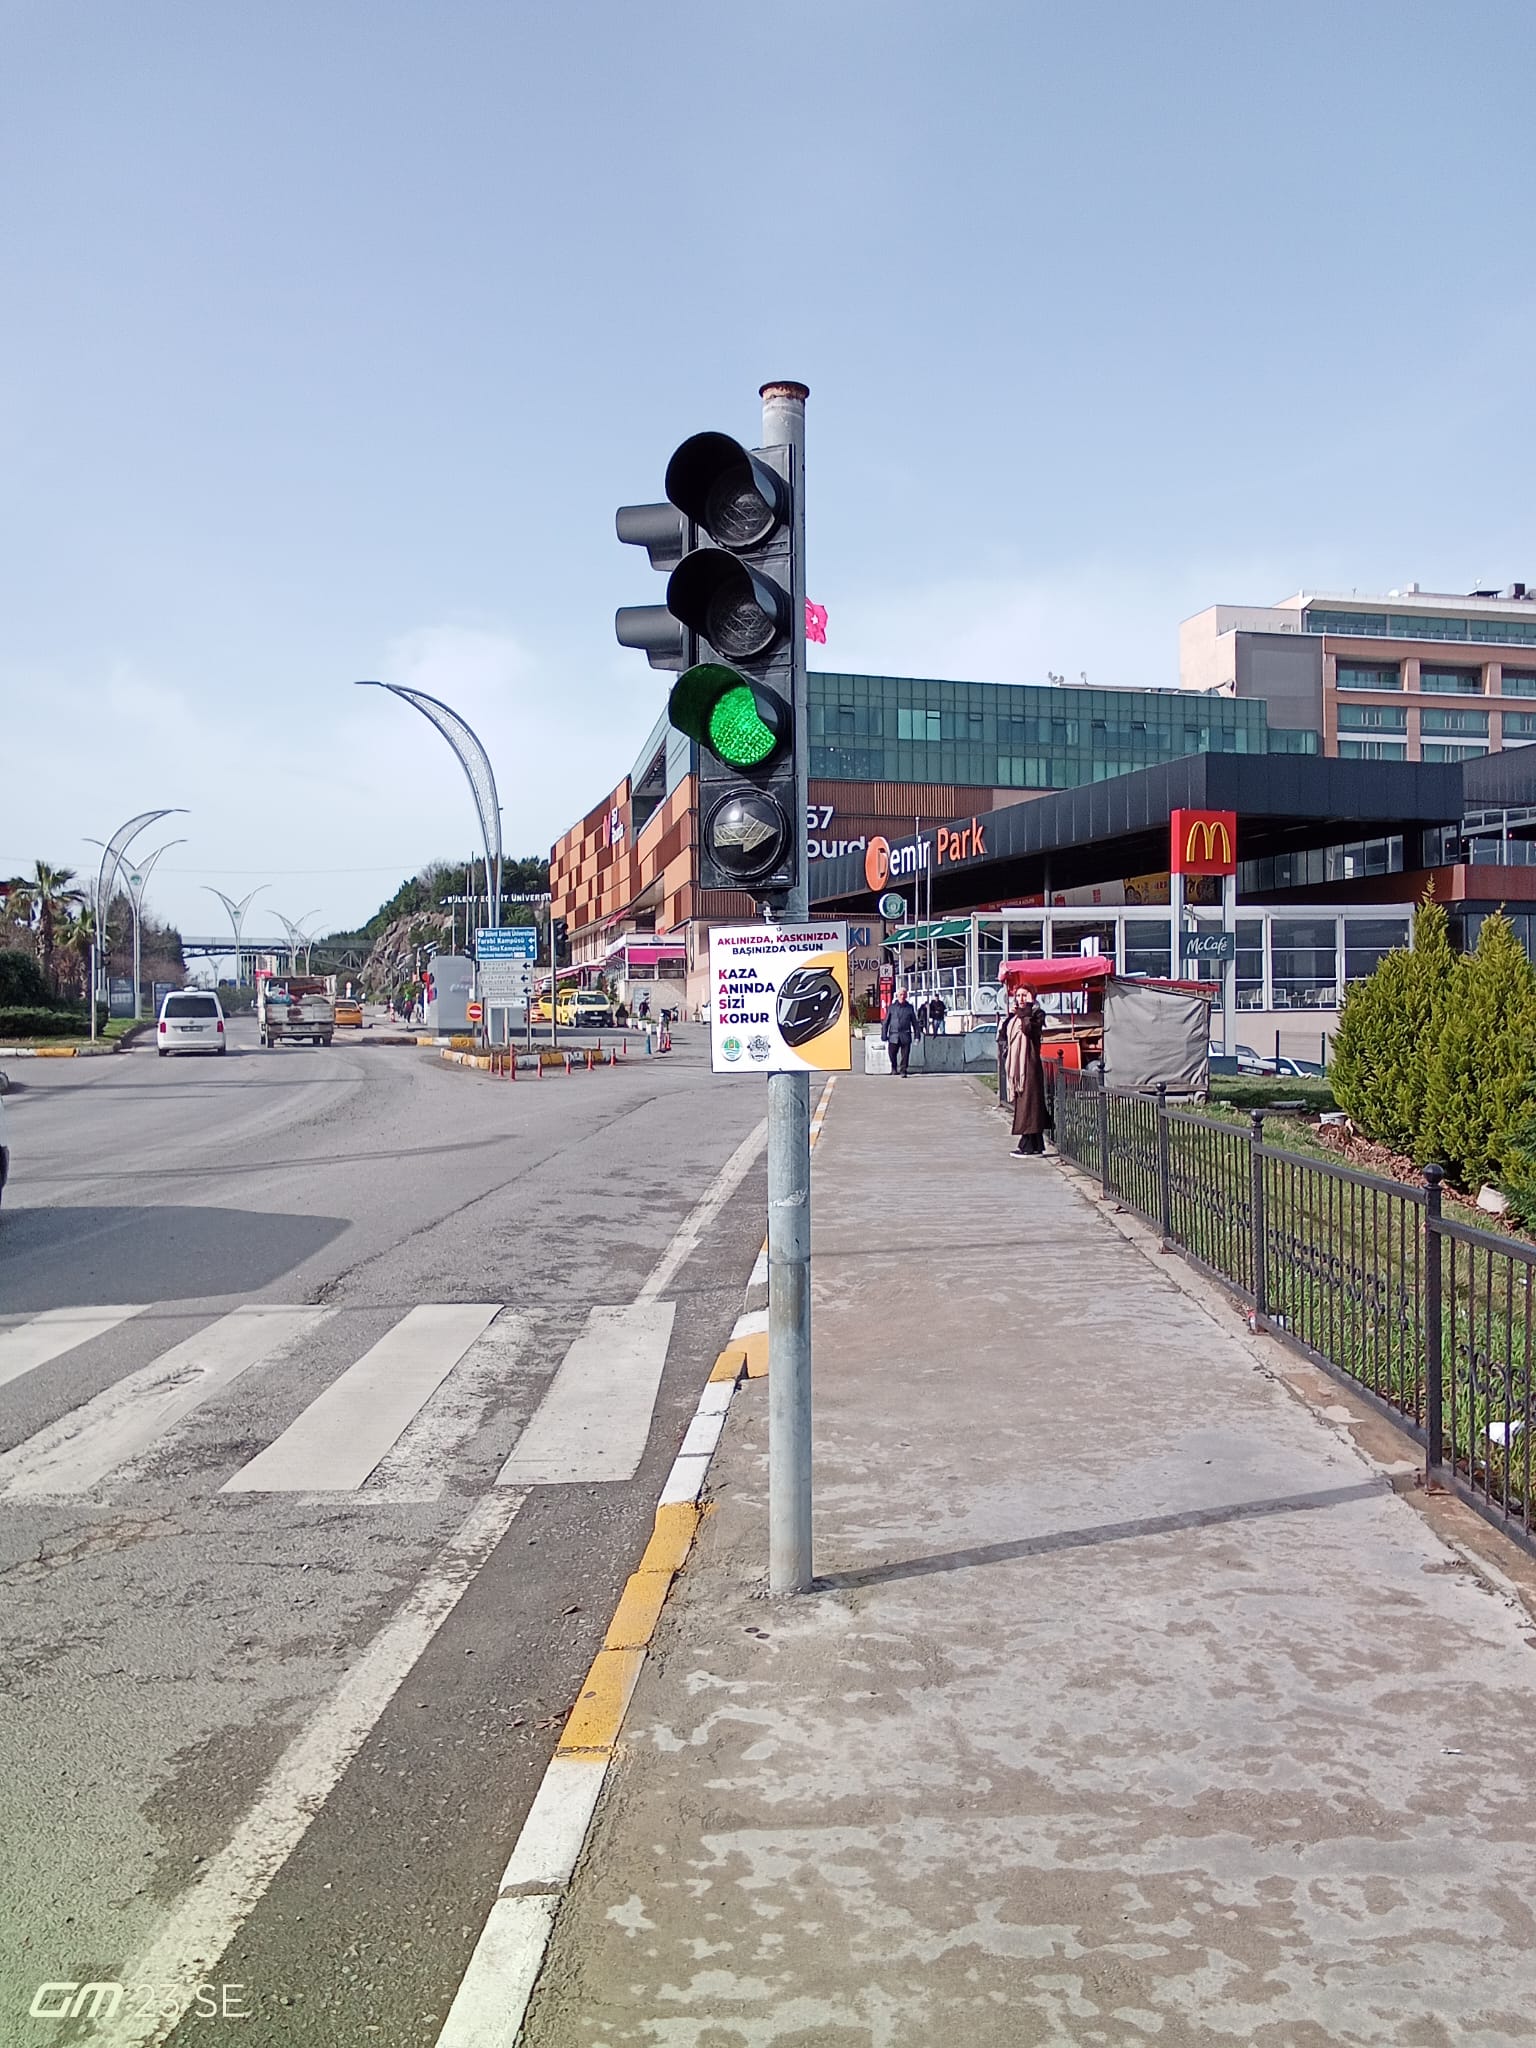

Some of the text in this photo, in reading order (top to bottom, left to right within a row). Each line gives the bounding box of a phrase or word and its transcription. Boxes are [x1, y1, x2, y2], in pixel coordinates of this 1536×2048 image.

[937, 818, 988, 864] Park
[717, 932, 839, 946] AKLINIZDA, KASKINIZDA
[1186, 936, 1228, 955] McCafé
[732, 943, 823, 956] BAŞINIZDA OLSUN
[718, 968, 757, 980] KAZA
[718, 982, 775, 994] ANINDA
[719, 995, 745, 1009] SİZİ
[720, 1012, 769, 1024] KORUR
